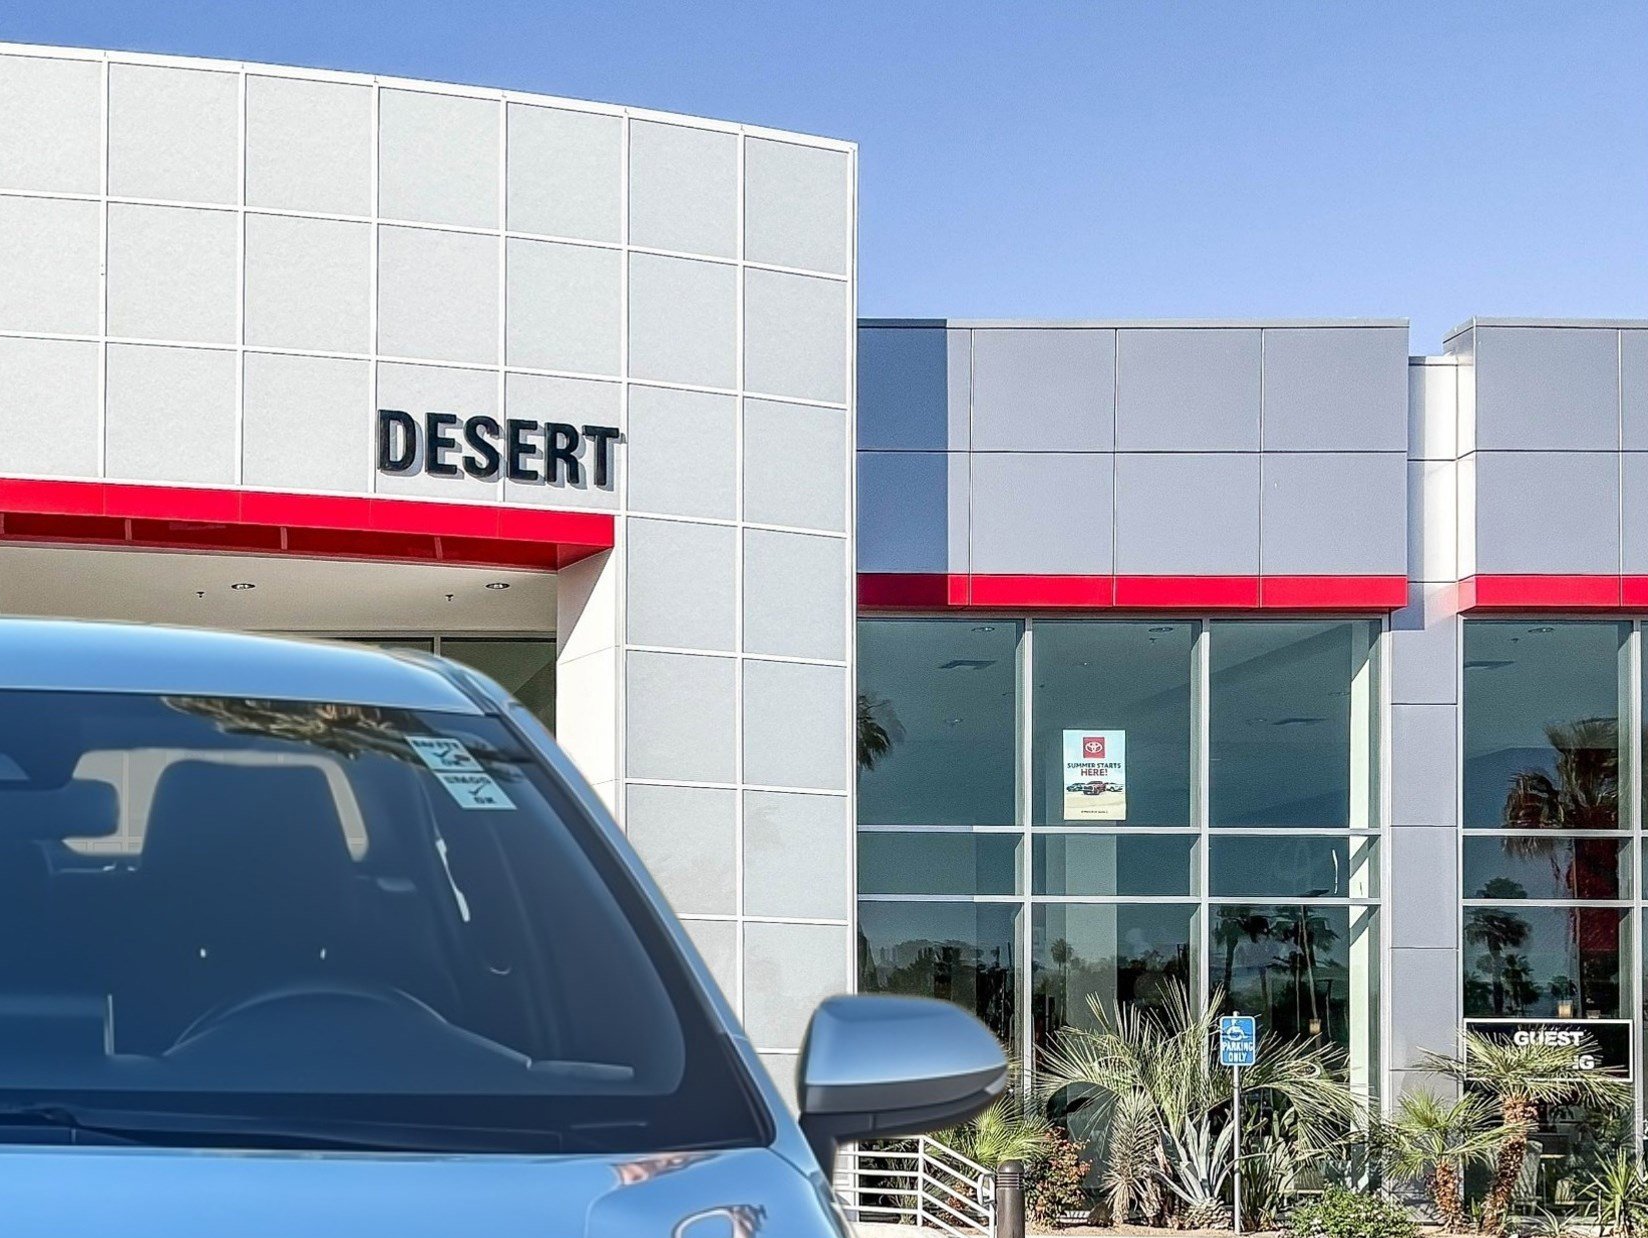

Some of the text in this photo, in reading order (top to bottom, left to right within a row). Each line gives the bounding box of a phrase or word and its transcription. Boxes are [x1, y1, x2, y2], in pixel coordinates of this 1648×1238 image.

[377, 409, 621, 487] DESERT
[1080, 768, 1108, 776] HERE!
[1513, 1030, 1584, 1047] GUEST
[1222, 1041, 1254, 1052] PARKING
[1228, 1052, 1247, 1062] ONLY
